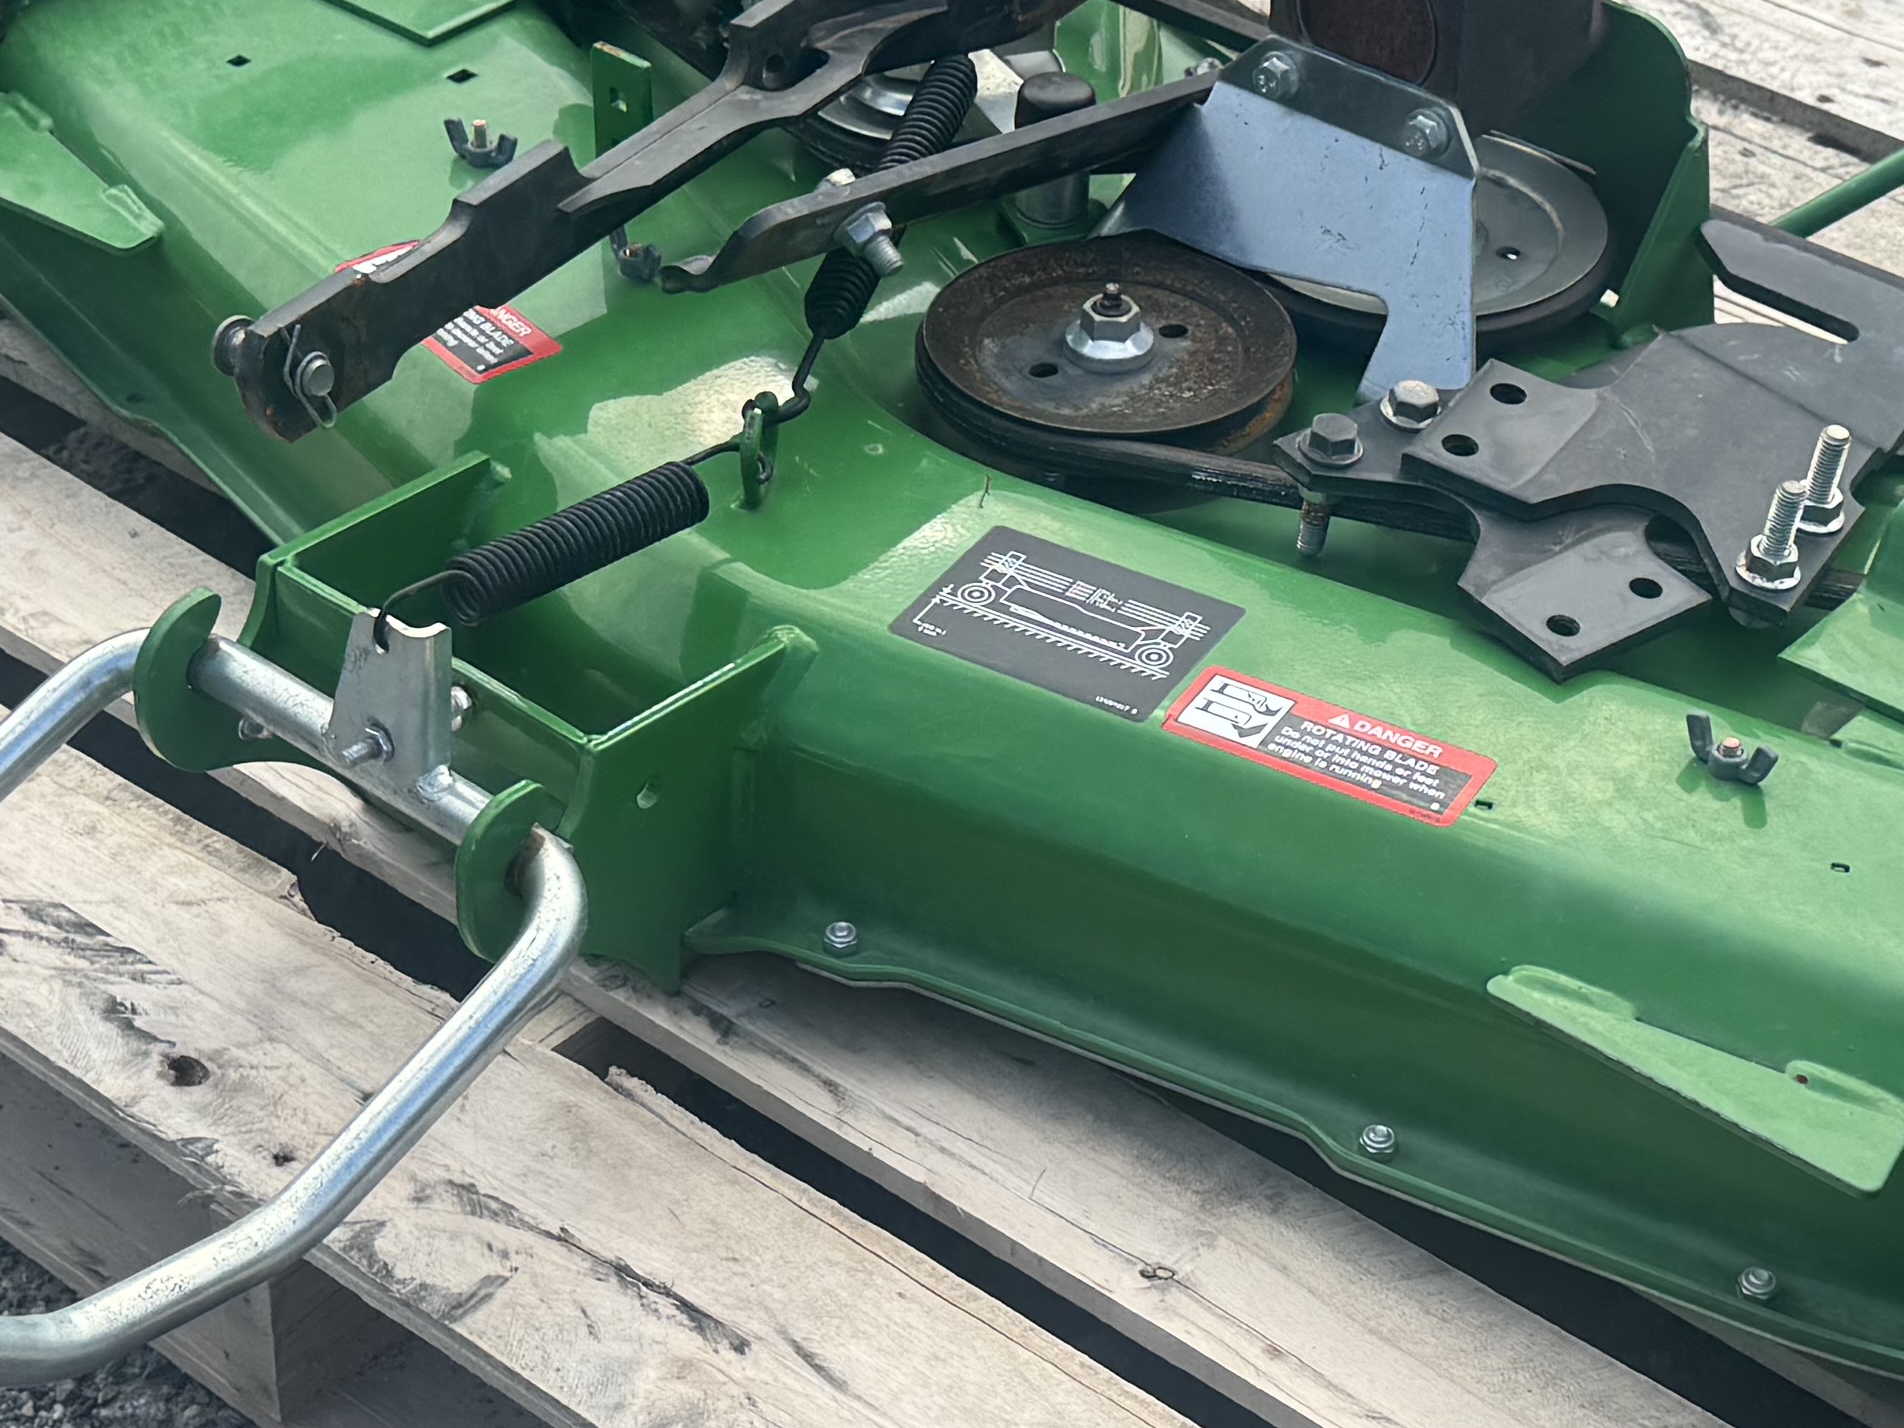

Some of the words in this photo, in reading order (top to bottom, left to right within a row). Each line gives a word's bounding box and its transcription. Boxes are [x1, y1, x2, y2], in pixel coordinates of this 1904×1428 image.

[490, 308, 532, 337] NGER
[1281, 727, 1300, 739] Do
[1302, 735, 1325, 748] not
[1326, 742, 1350, 757] put
[1351, 750, 1393, 771] hands
[1395, 767, 1413, 776] or
[1412, 772, 1440, 787] feet
[1300, 721, 1382, 756] ROTATING
[1384, 749, 1440, 775] BLADE
[1354, 720, 1443, 758] DANGER
[1267, 743, 1313, 764] engine
[1314, 758, 1327, 768] is
[1329, 764, 1382, 788] running
[1275, 735, 1314, 753] under
[1315, 749, 1330, 759] or
[1332, 753, 1357, 769] into
[1361, 765, 1407, 785] mower
[1409, 781, 1445, 800] when
